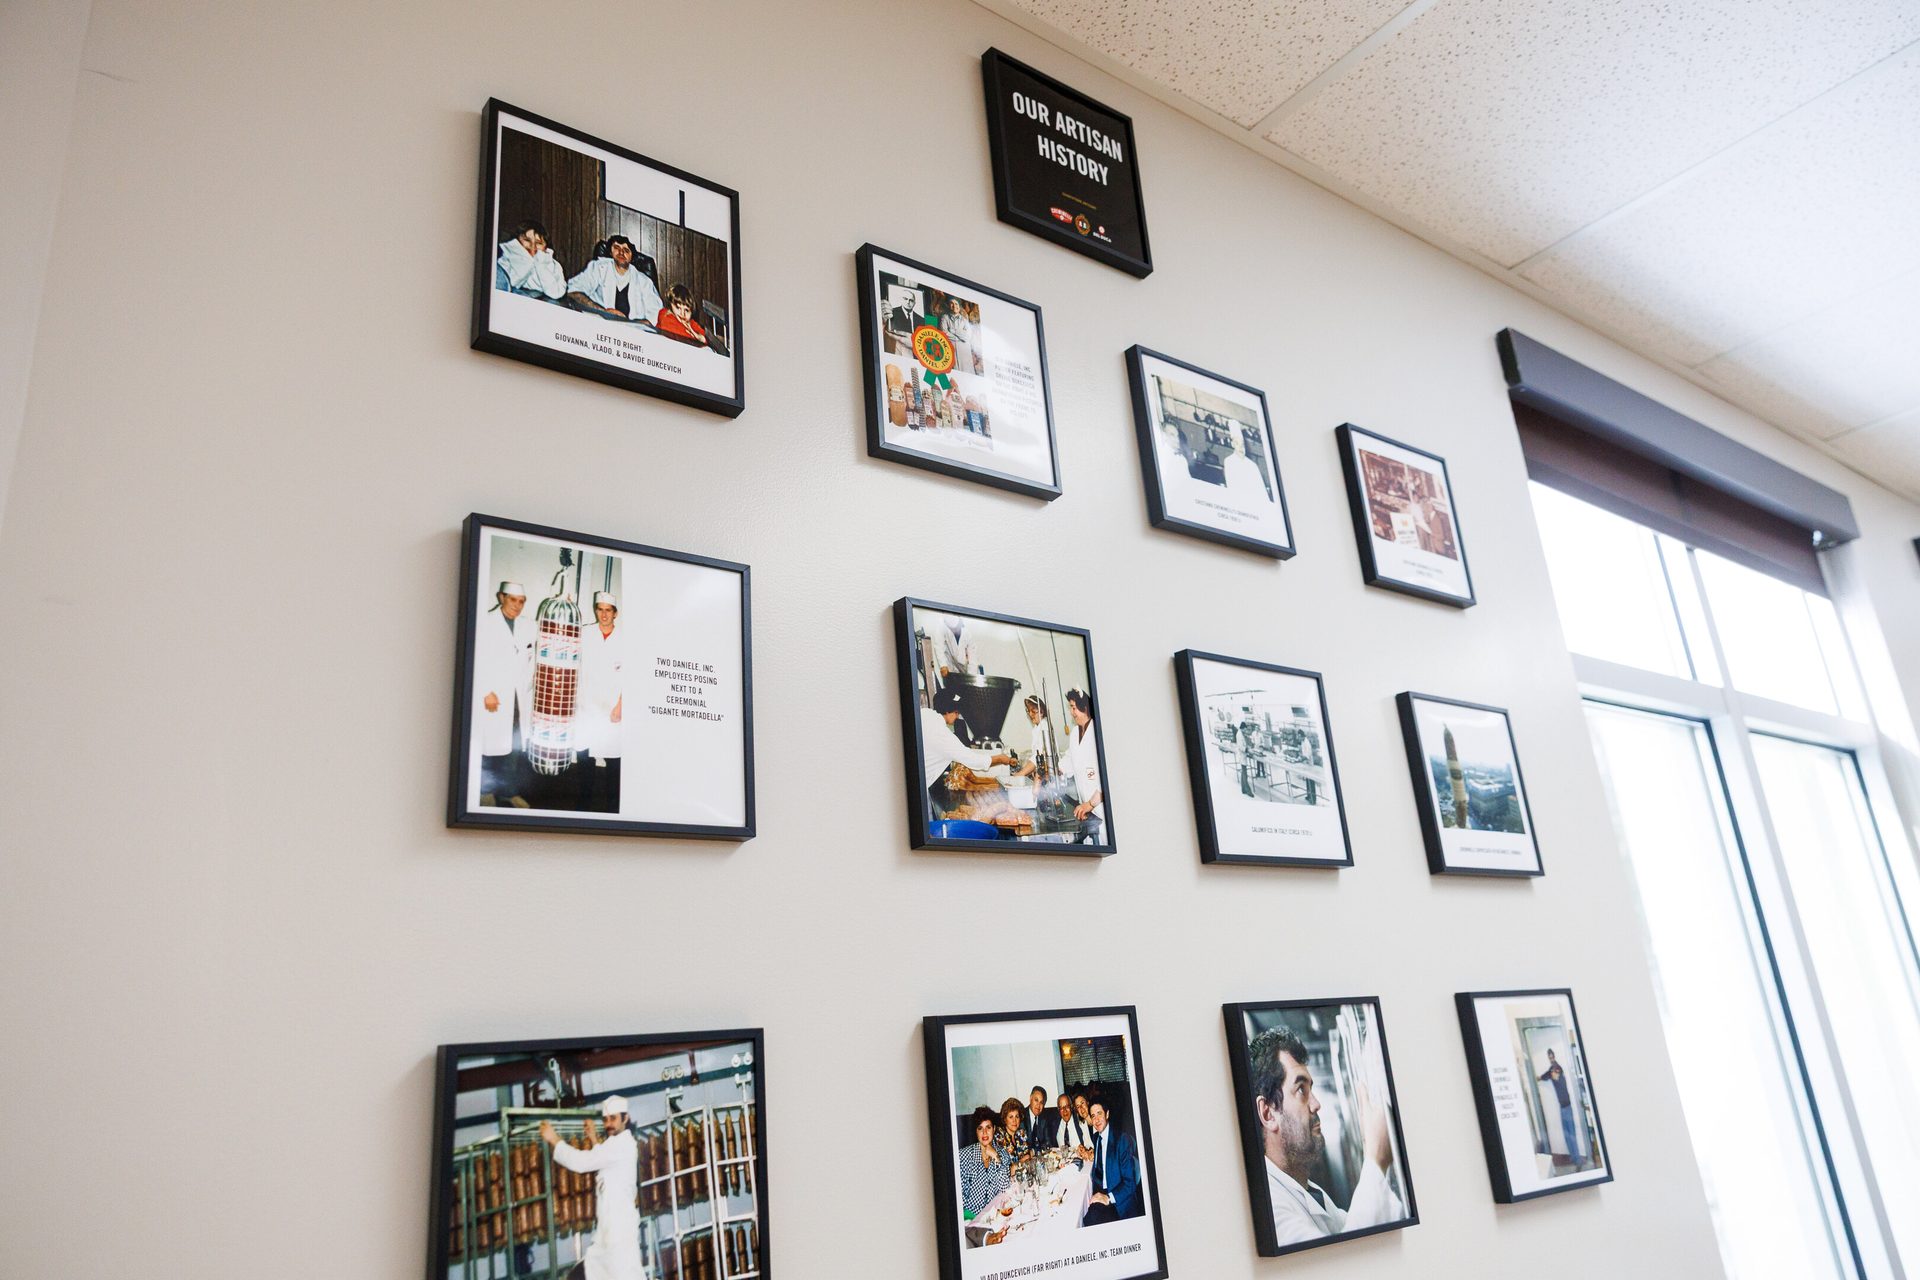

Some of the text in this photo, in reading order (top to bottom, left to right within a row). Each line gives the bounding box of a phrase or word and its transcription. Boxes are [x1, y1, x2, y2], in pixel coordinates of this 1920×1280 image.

[1013, 91, 1123, 163] OUR ARTISAN
[1037, 134, 1108, 186] HISTORY
[554, 332, 682, 374] GIOVANNA, VLADO, & DAVIDE DUKCEVICH
[596, 333, 644, 354] LEFT TO RIGHT:
[656, 657, 716, 673] TWO DANIELE, INC.
[654, 669, 718, 685] EMPLOYEES POSING
[671, 684, 703, 695] NEXT TO A
[666, 695, 707, 708] CEREMONIAL
[648, 705, 724, 722] "GIGANTE MORTADELLA"
[999, 1266, 1031, 1280] DUKCEVICH
[1031, 1263, 1045, 1274] (FAR
[1045, 1259, 1064, 1271] RIGHT)
[1063, 1257, 1070, 1267] AT
[1070, 1257, 1075, 1265] A
[1075, 1251, 1098, 1265] DANIELE,
[1098, 1249, 1110, 1259] INC.
[1109, 1247, 1123, 1257] TEAM
[1123, 1243, 1142, 1254] DINNER
